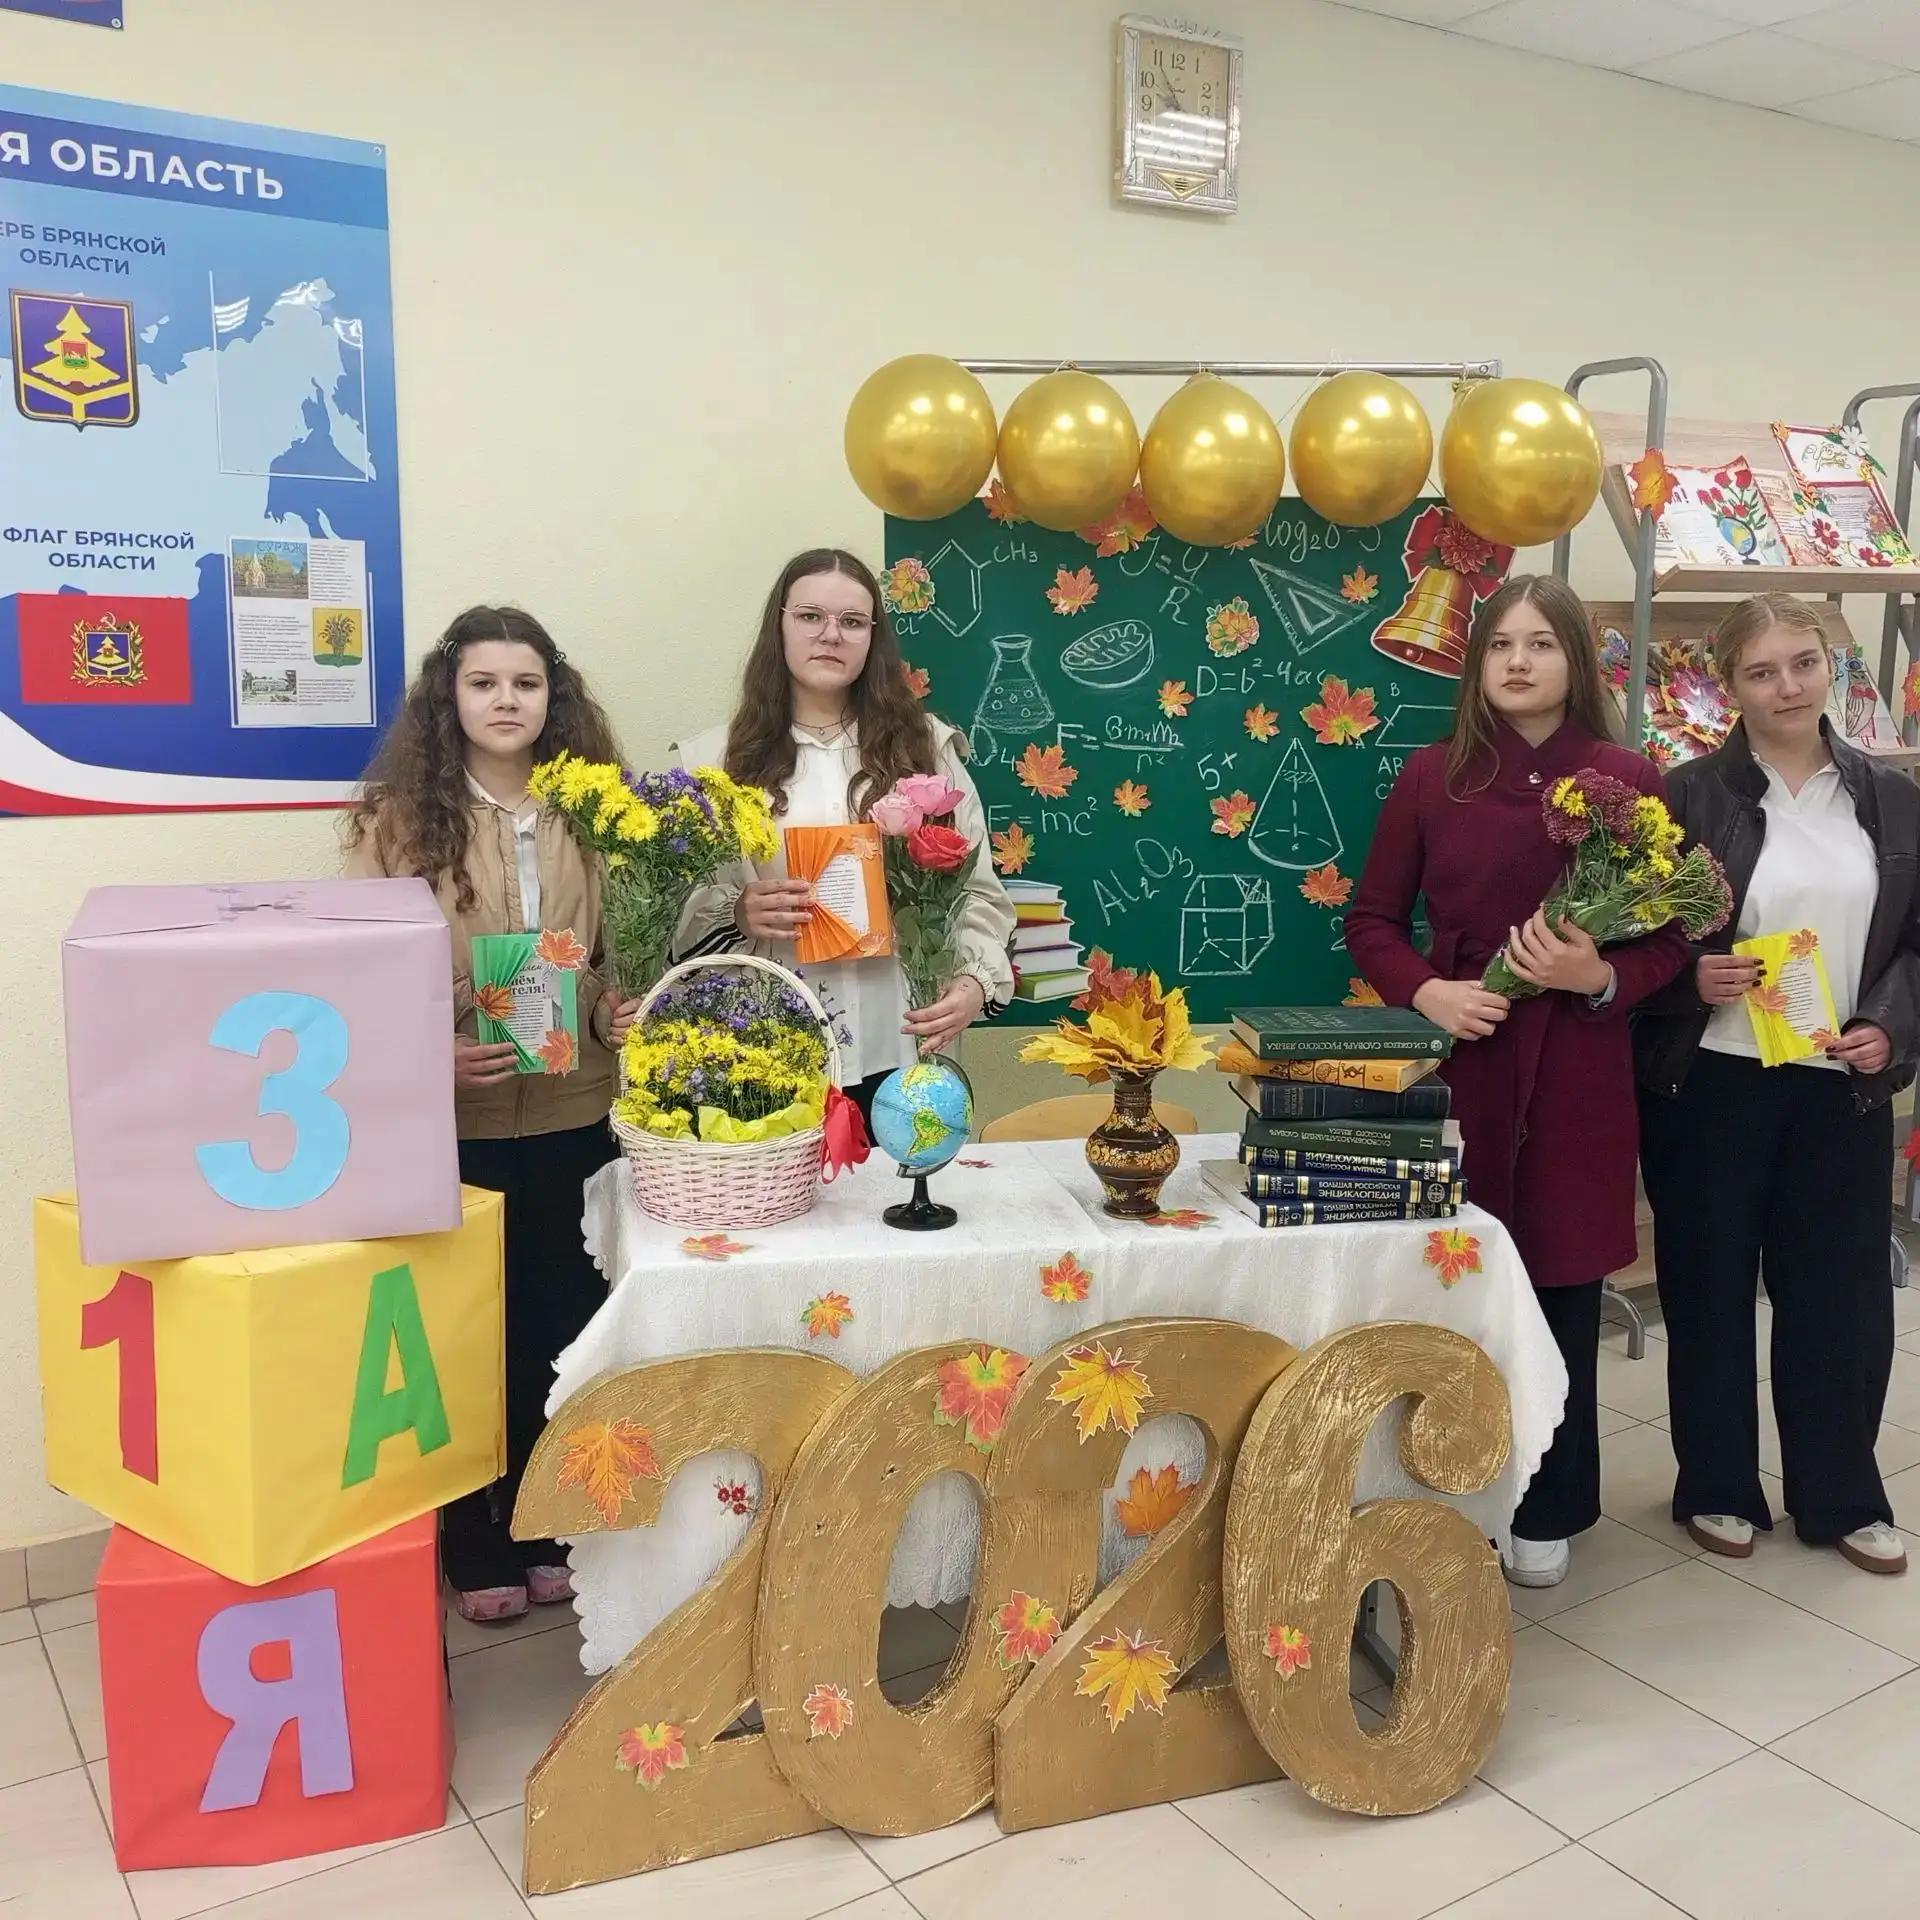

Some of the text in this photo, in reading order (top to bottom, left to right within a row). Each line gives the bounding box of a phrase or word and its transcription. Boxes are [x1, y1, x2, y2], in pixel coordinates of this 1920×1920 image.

[1153, 49, 1163, 66] 11
[1172, 52, 1186, 71] 12
[1141, 71, 1155, 89] 10
[1201, 83, 1211, 99] 2
[1141, 95, 1152, 111] 9
[50, 138, 284, 200] ОБЛАСТЬ
[42, 226, 166, 256] БРЯНСКОЙ
[20, 248, 130, 275] ОБЛАСТИ
[3, 526, 195, 550] ФЛАГ БРЯНСКОЙ
[256, 541, 304, 554] СУРАЖ
[49, 552, 156, 571] ОБЛАСТИ
[511, 984, 546, 996] теля!
[1266, 1042, 1296, 1051] ЯЗЫКА
[1297, 1042, 1342, 1051] РУССКОГО
[1343, 1041, 1381, 1050] СЛОВАРЬ
[1305, 1151, 1388, 1167] ЭНЦИКЛОПЕДИЯ
[1352, 1165, 1387, 1175] БОЛЬШАЯ
[1283, 1182, 1295, 1195] 13
[1318, 1181, 1401, 1190] БОЛЬШАЯ РОССИЙСКАЯ
[1318, 1189, 1401, 1199] ЭНЦИКЛОПЕДИЯ
[1323, 1203, 1354, 1212] БОЛЬШАЯ
[1323, 1209, 1398, 1222] ЭНЦИКЛОПЕДИЯ
[80, 1269, 159, 1487] 1
[510, 1316, 1512, 1896] 2026
[197, 1588, 357, 1813] Я
